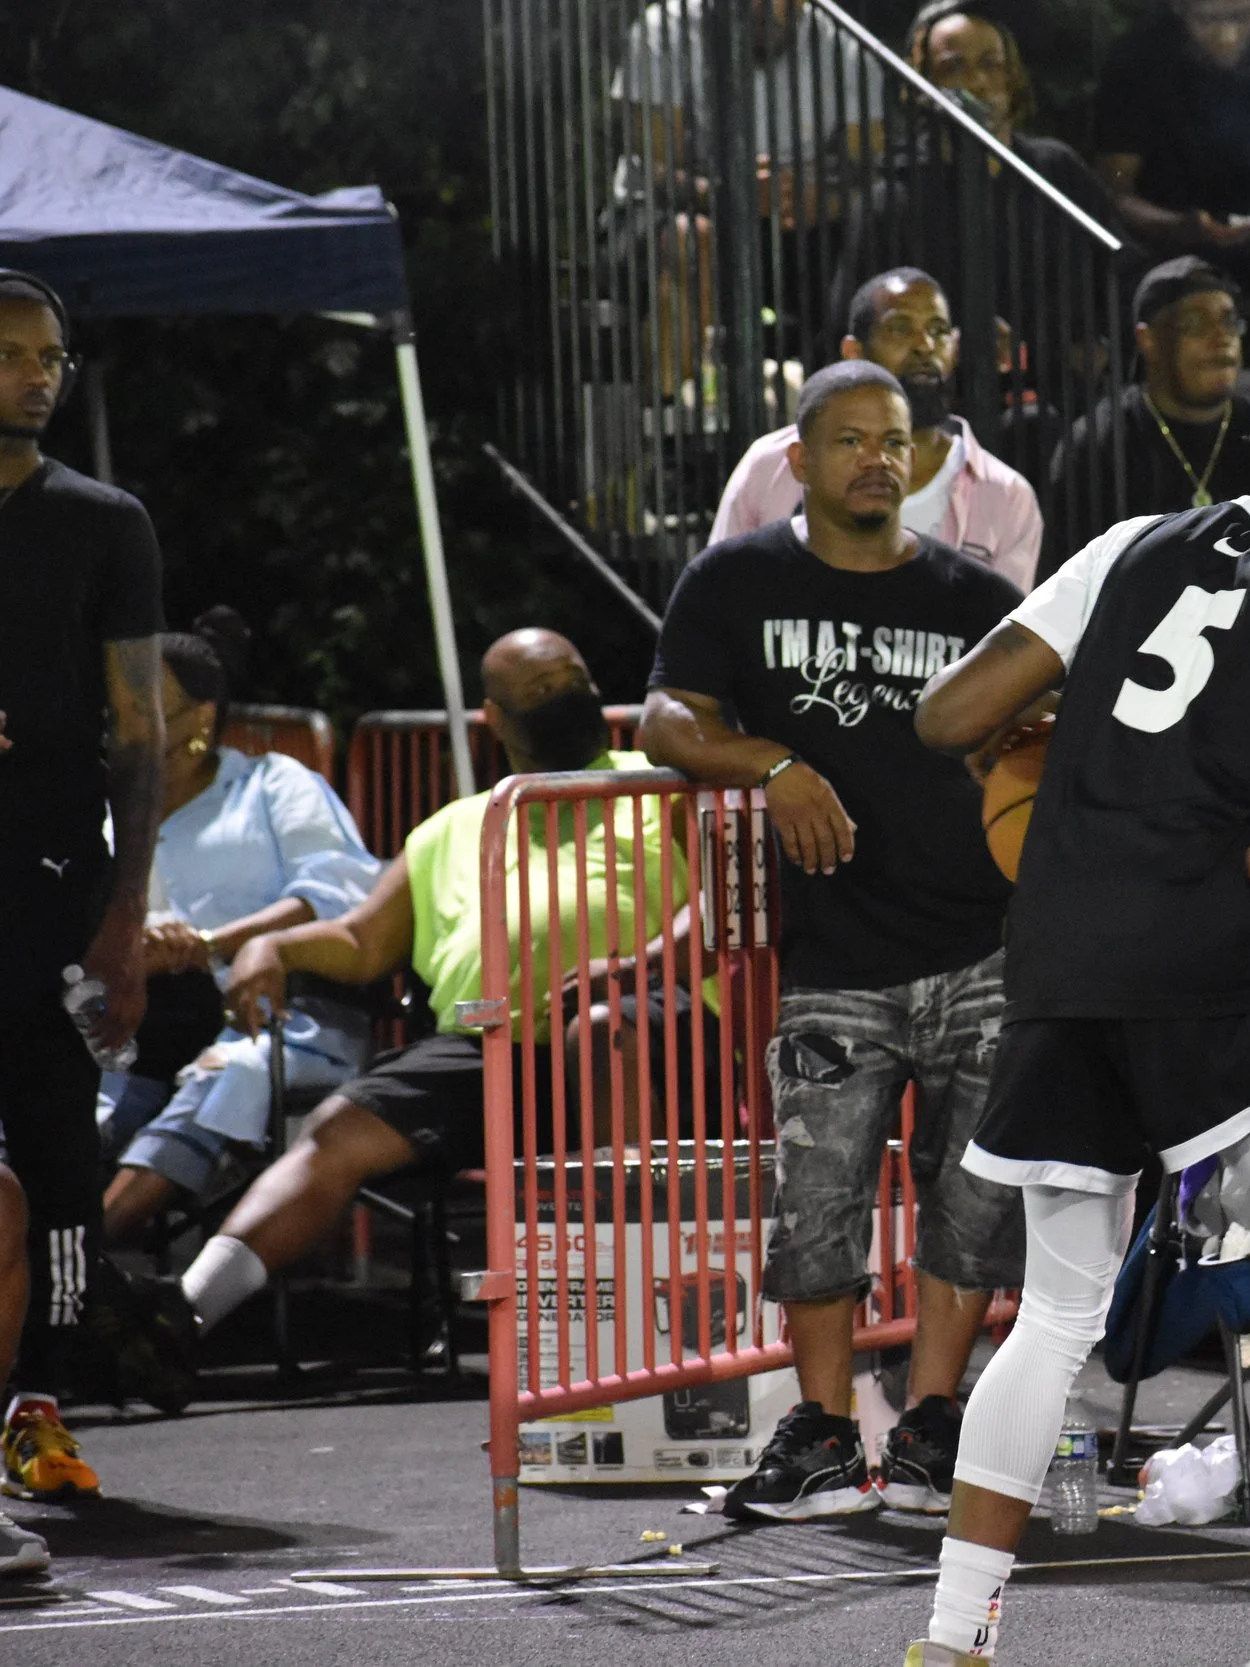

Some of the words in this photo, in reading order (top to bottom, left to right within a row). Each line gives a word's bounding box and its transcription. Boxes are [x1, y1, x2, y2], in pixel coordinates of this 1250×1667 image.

[763, 619, 809, 669] I'M
[815, 620, 837, 669] A
[842, 621, 965, 679] T-SHIRT
[1112, 585, 1247, 733] 5
